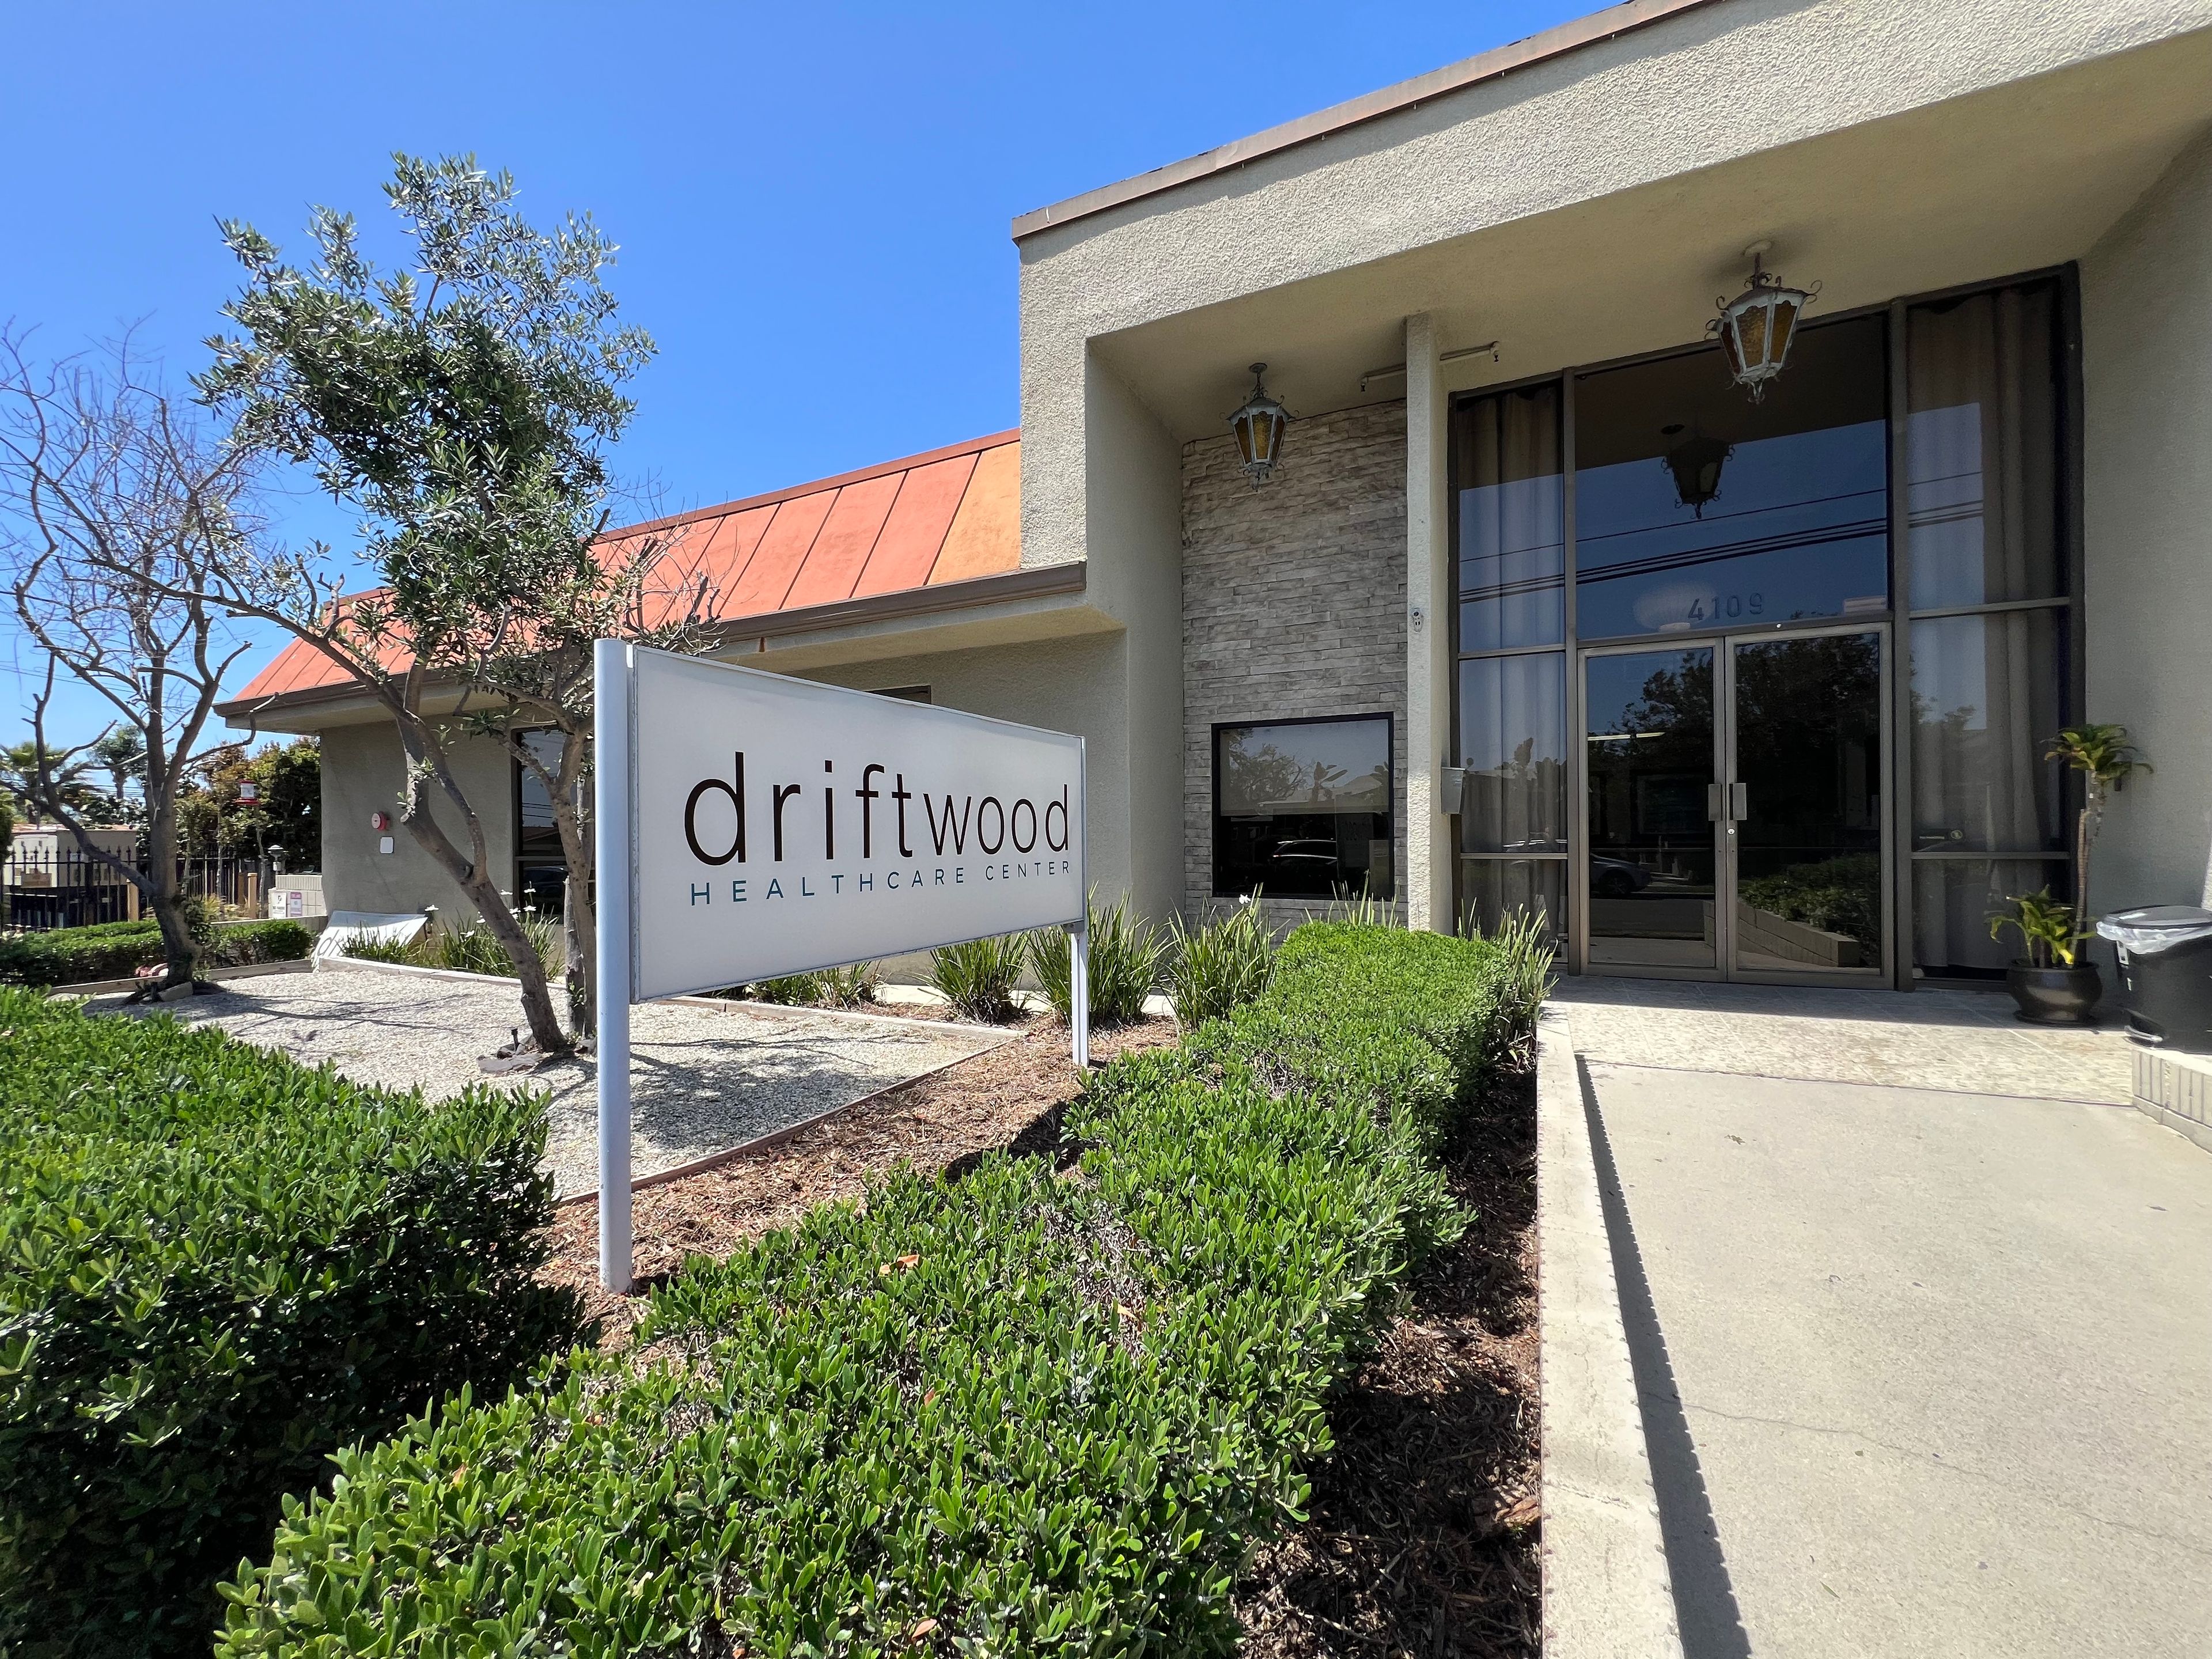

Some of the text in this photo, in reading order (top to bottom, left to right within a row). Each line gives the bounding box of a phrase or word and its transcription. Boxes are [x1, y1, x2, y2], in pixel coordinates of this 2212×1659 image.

[1687, 593, 1764, 620] 4109
[684, 751, 1069, 866] driftwood
[691, 861, 1070, 906] HEALTHCARE CENTER
